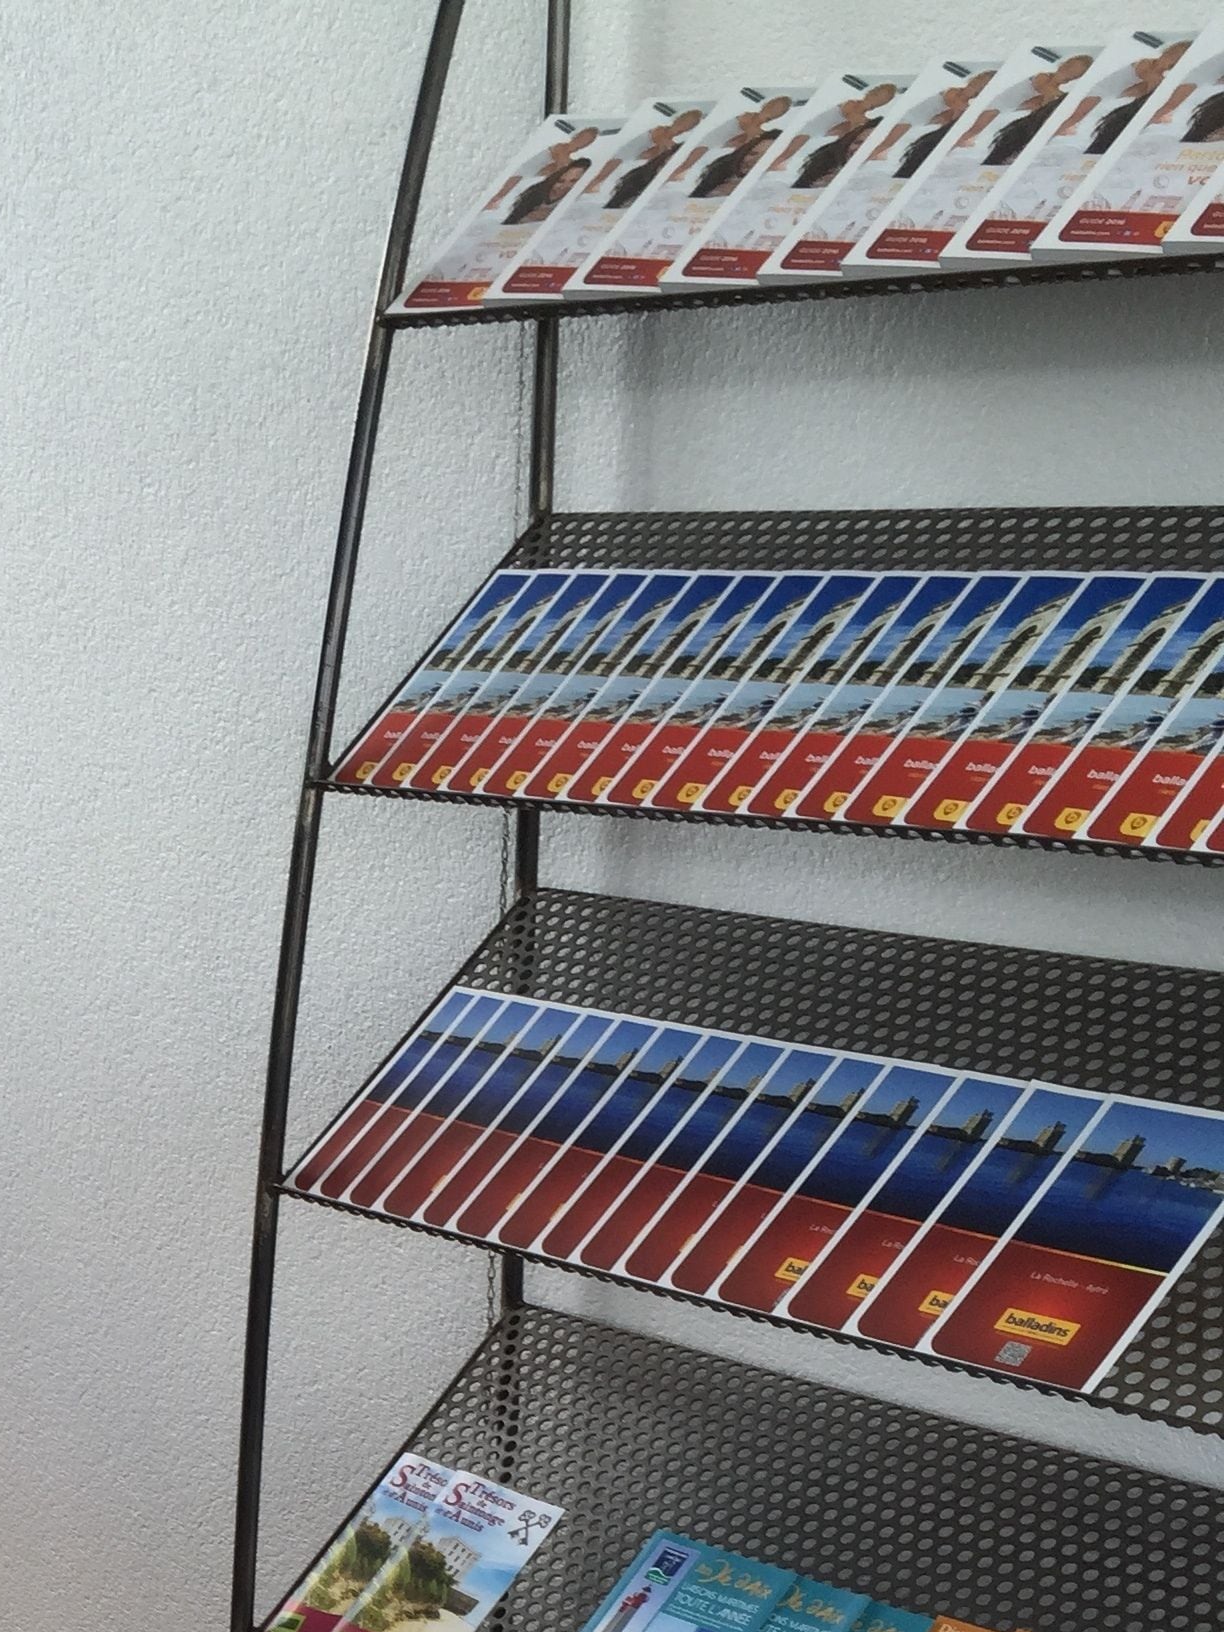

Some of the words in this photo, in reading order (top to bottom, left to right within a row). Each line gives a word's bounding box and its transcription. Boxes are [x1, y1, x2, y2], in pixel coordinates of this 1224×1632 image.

[1003, 1311, 1072, 1340] balladins
[444, 1482, 505, 1527] Saintonge
[470, 1481, 517, 1511] Trésors
[674, 1591, 710, 1612] TOUTE
